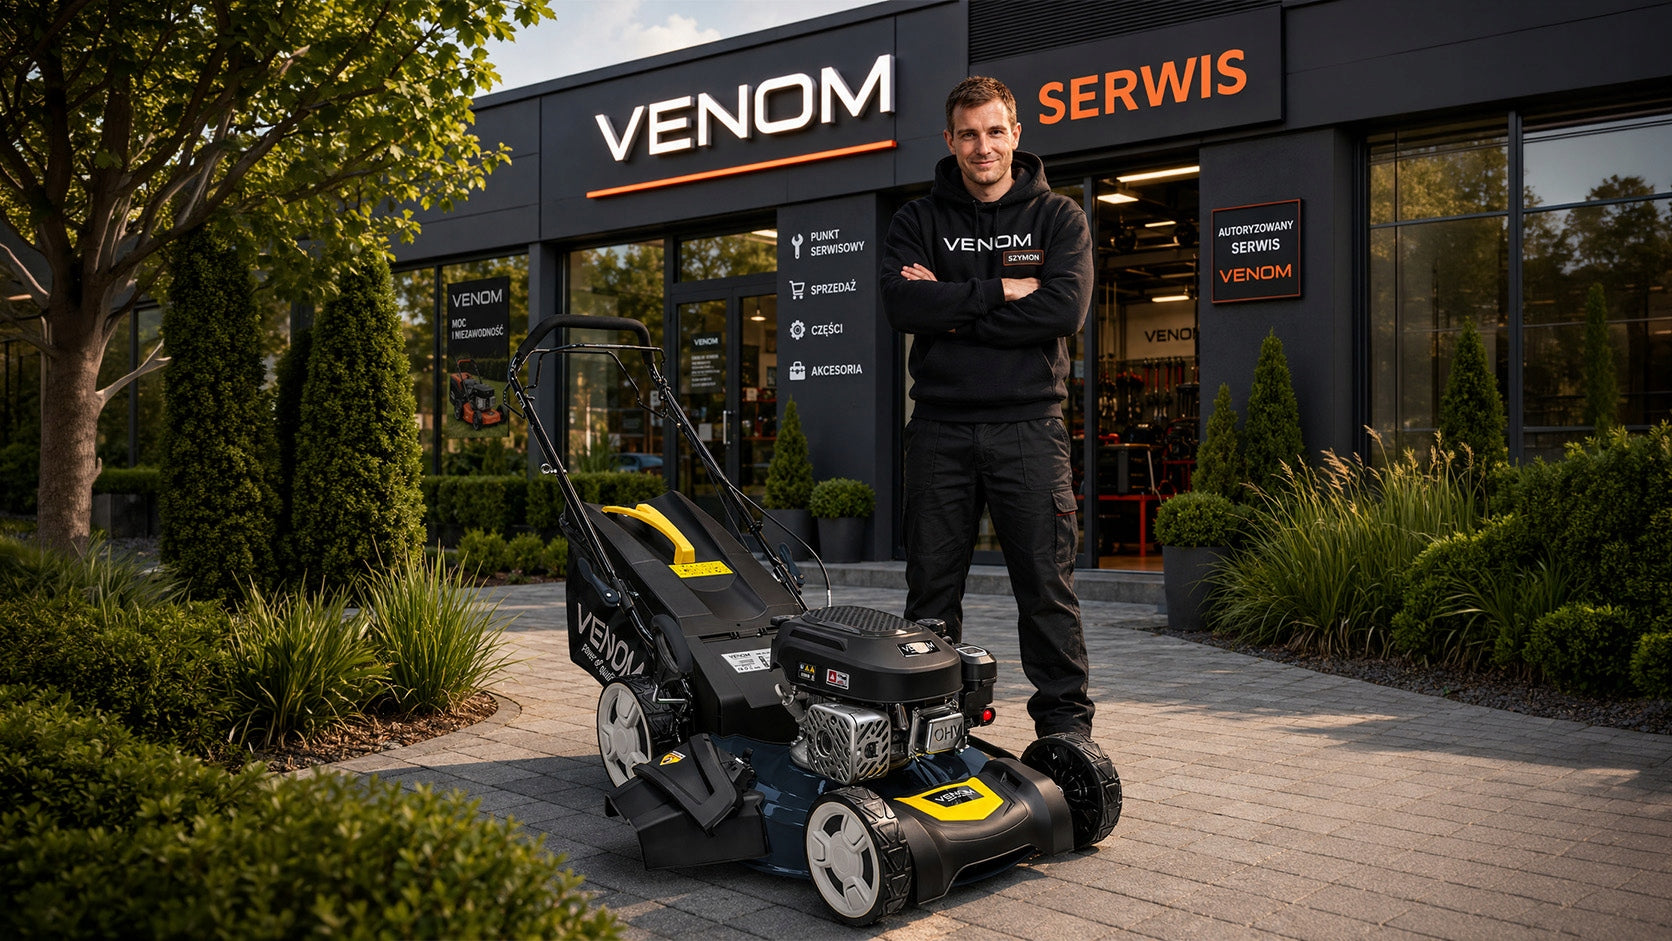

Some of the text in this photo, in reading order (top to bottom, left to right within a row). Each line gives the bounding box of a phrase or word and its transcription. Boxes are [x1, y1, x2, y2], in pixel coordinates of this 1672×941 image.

[1038, 49, 1247, 125] SERWIS
[595, 54, 895, 162] VENOM
[810, 229, 840, 241] PUNKT
[1218, 220, 1294, 237] AUTORYZOWANY
[810, 241, 865, 256] SERWISOWY
[943, 233, 1032, 252] VENOM
[1231, 238, 1280, 254] SERWIS
[1008, 254, 1040, 262] SZYMON
[1219, 264, 1292, 283] VENOM
[810, 279, 857, 295] SPRZEDAŻ
[452, 289, 503, 307] VENOM
[451, 318, 466, 328] MOC
[811, 322, 843, 337] CZĘŚCI
[455, 324, 504, 340] NIEZAWODNOŚĆ
[693, 337, 719, 346] VENOM
[811, 364, 863, 376] AKCESORIA
[577, 602, 645, 677] VENOM
